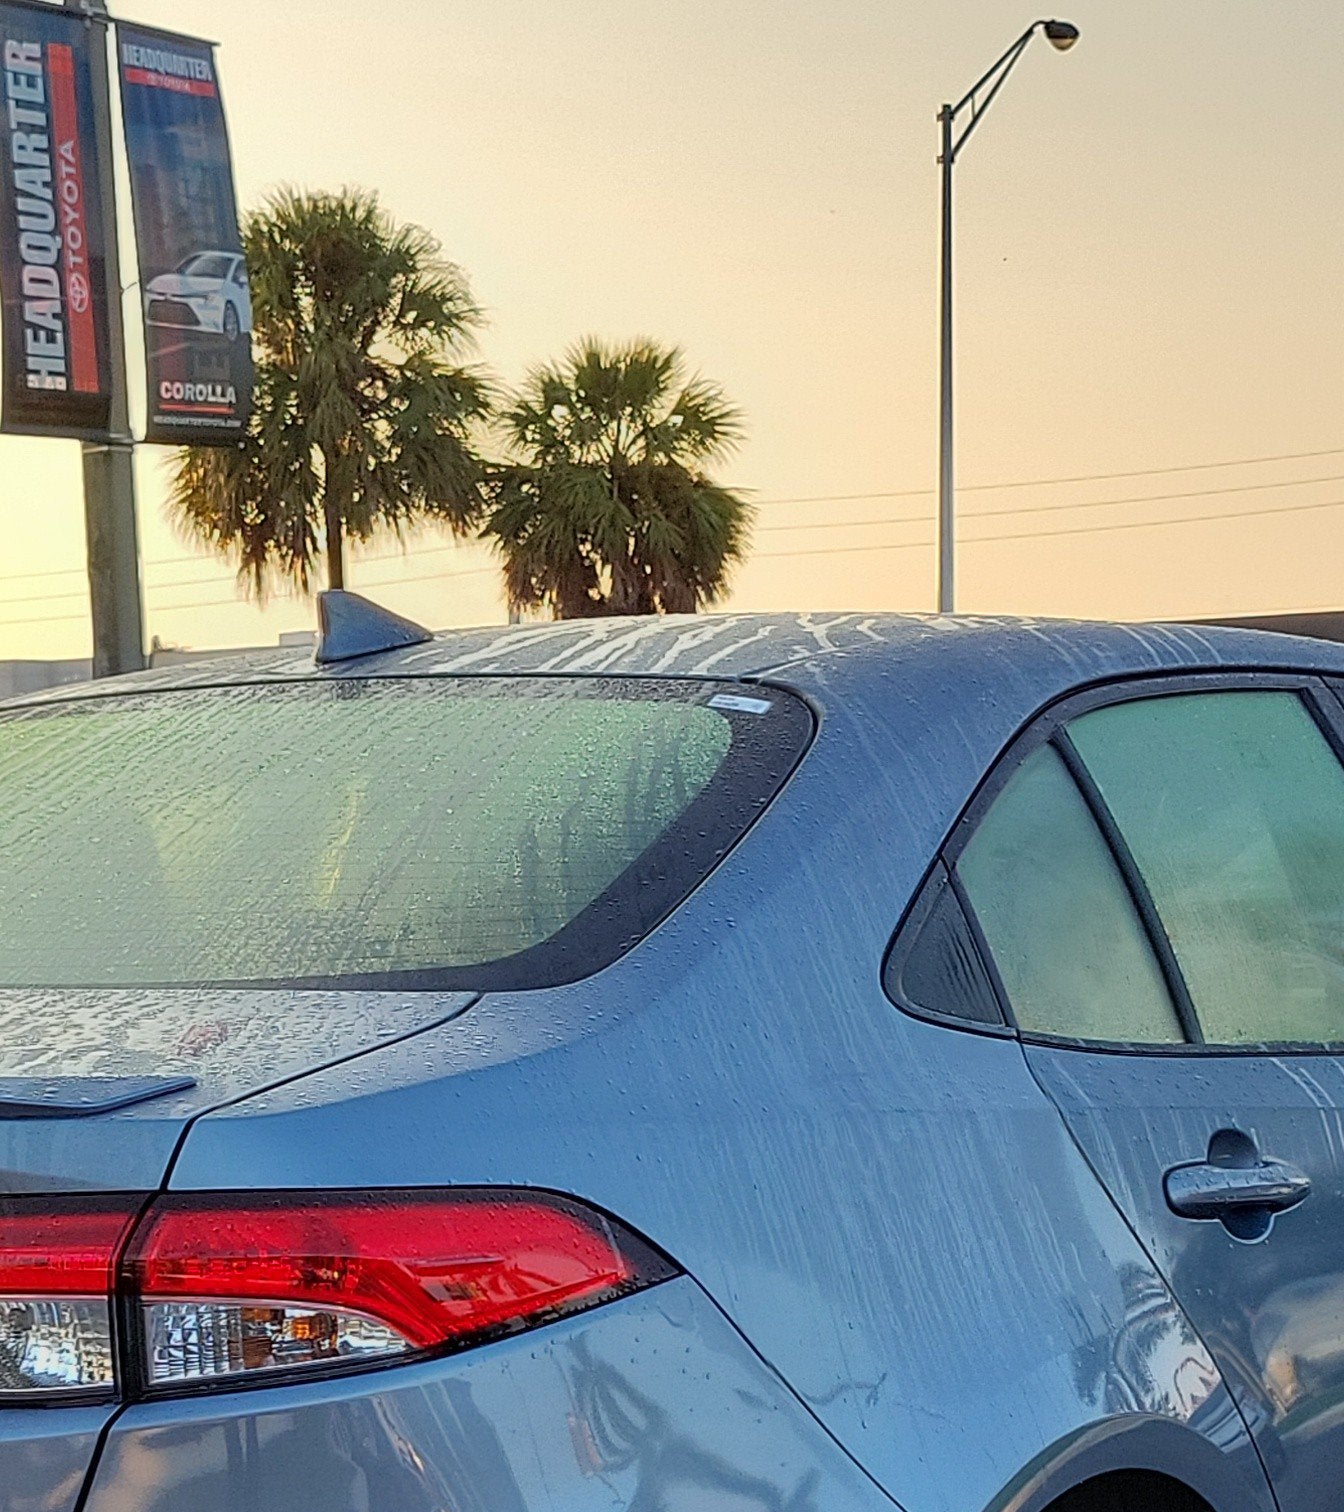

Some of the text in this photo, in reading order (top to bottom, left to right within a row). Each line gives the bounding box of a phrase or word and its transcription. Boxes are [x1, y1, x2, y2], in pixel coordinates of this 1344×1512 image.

[4, 39, 67, 391] HEADQUARTER
[60, 140, 84, 268] TOYOTA
[159, 380, 236, 404] COROLLA
